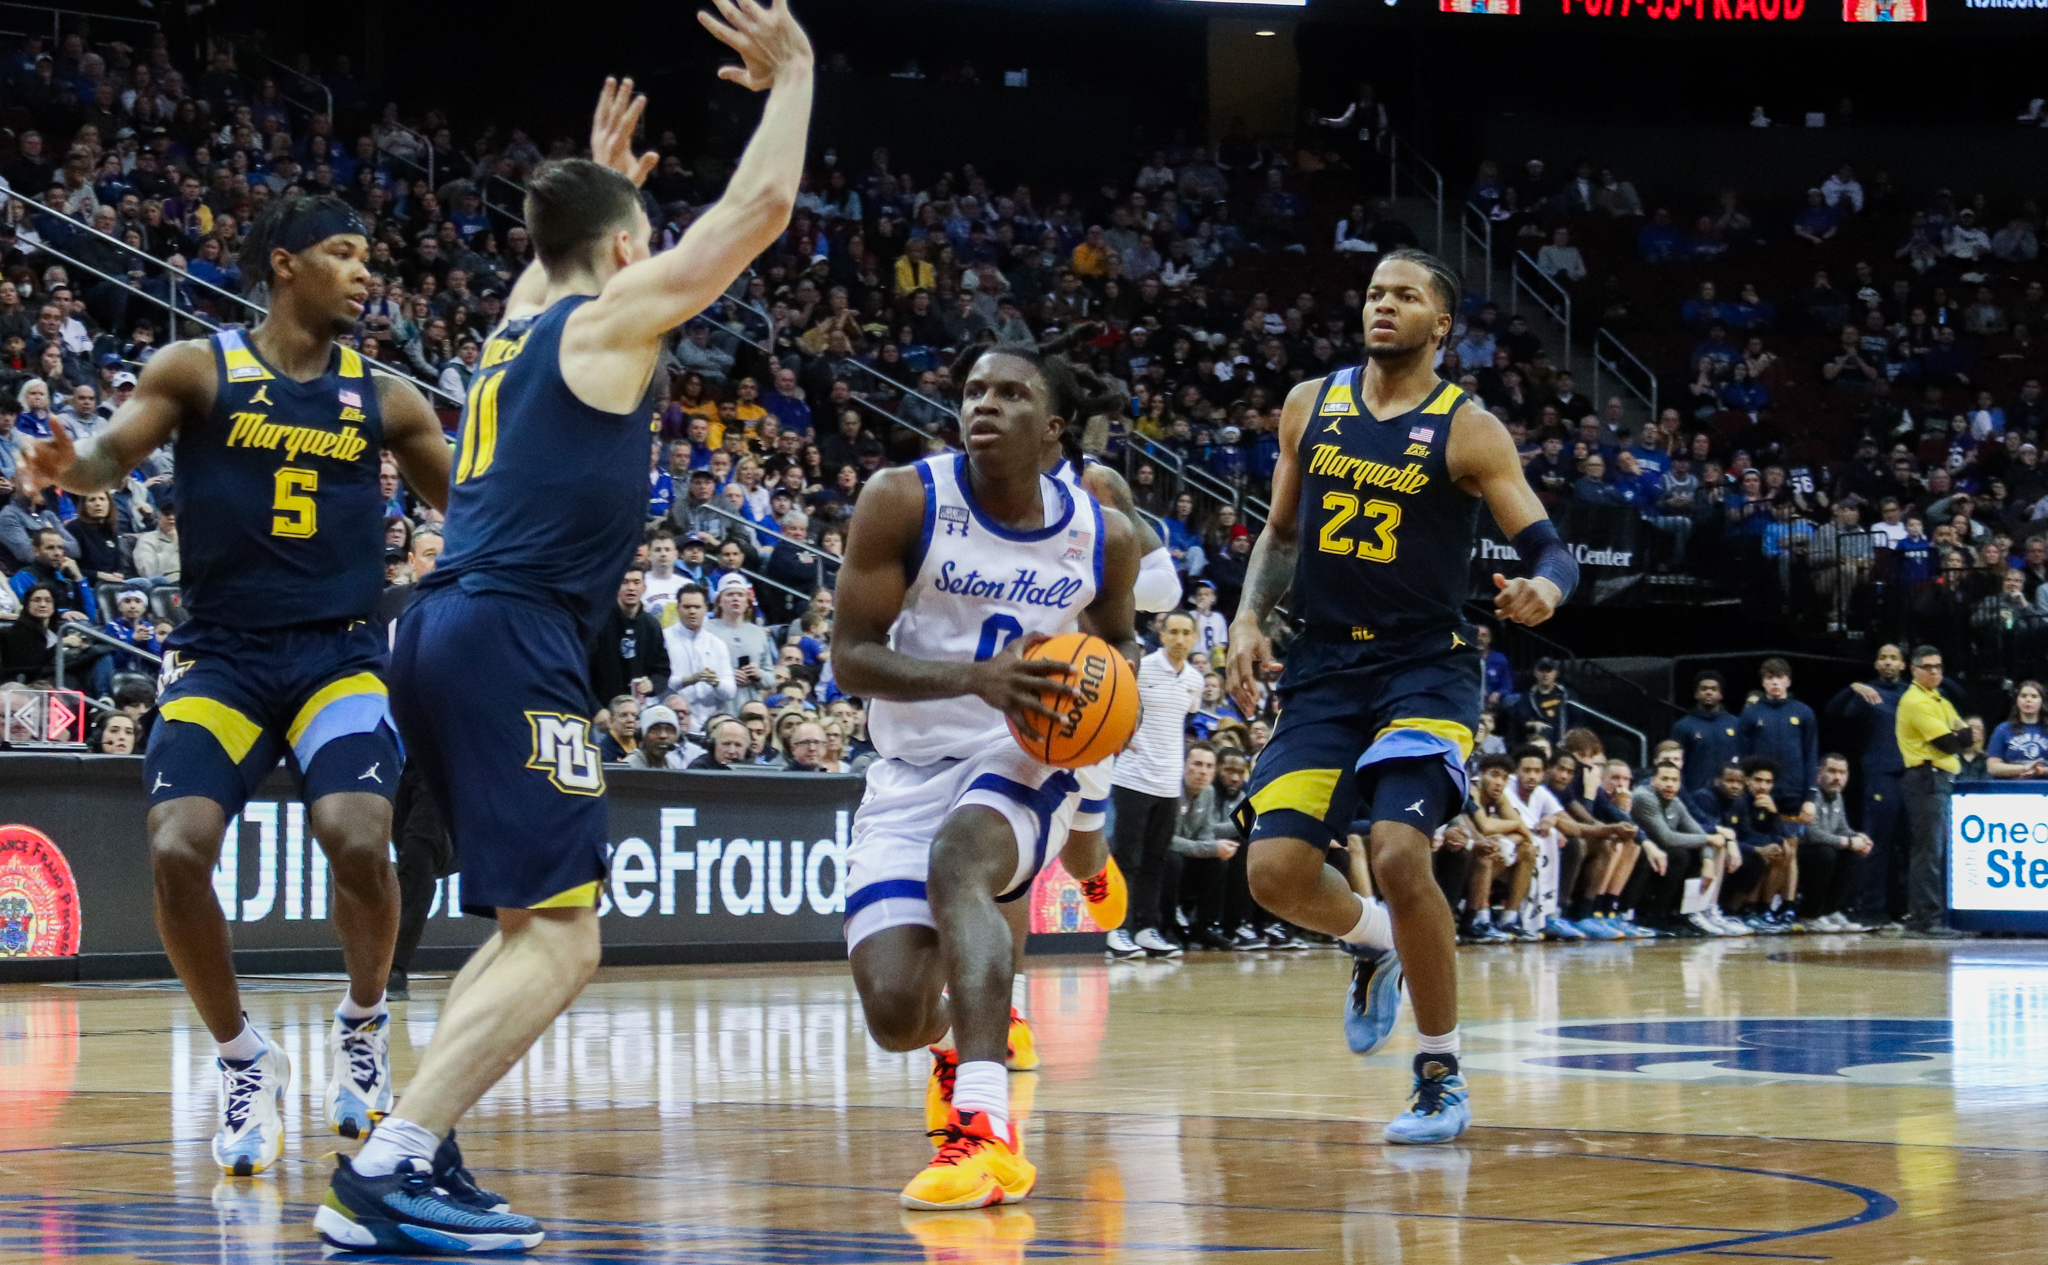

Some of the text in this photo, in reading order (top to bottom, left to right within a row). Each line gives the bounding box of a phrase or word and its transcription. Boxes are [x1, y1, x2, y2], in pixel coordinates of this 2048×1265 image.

[227, 412, 367, 461] Marquette
[1309, 443, 1430, 495] Marquette
[271, 467, 318, 539] 5
[1319, 491, 1402, 563] 23
[1576, 545, 1632, 567] Center
[935, 561, 1083, 609] Seton Hall
[527, 713, 603, 793] MU
[1987, 849, 2048, 889] Ste
